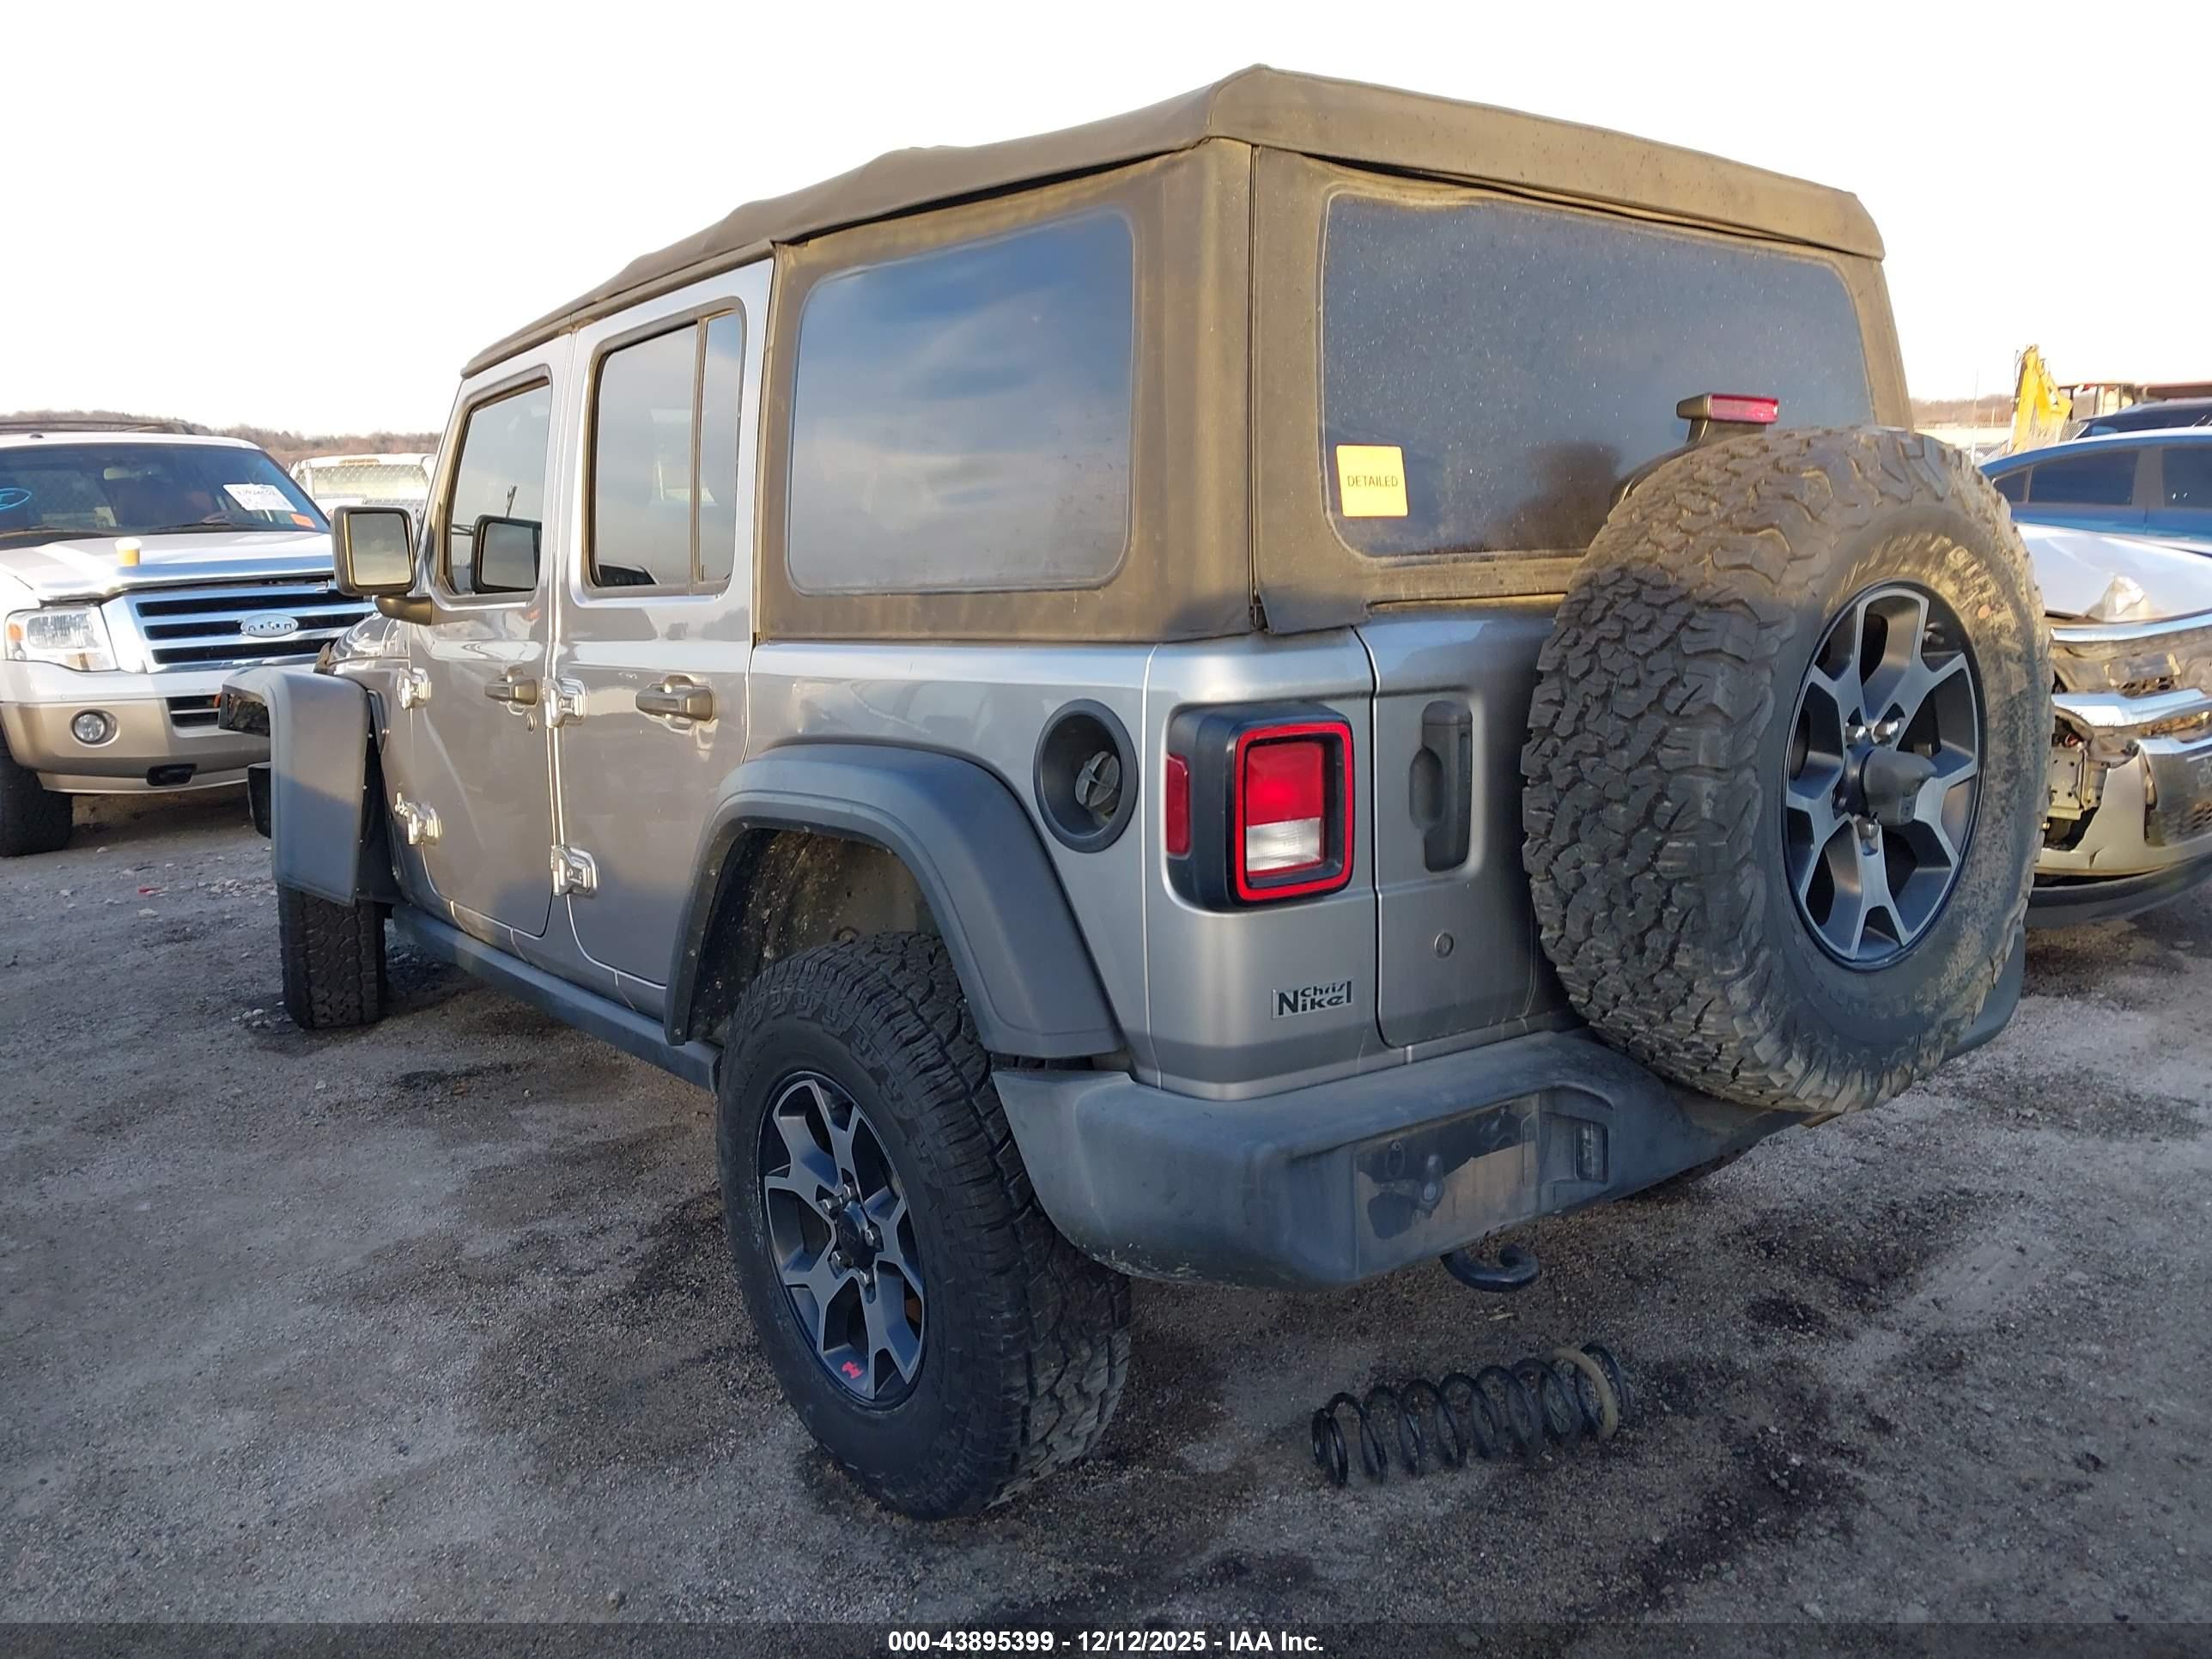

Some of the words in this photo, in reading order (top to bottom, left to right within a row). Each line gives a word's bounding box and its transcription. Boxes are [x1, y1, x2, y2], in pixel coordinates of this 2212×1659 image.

[1347, 475, 1398, 488] DETAILED
[1300, 982, 1346, 998] Chris
[1278, 981, 1352, 1016] Nikel
